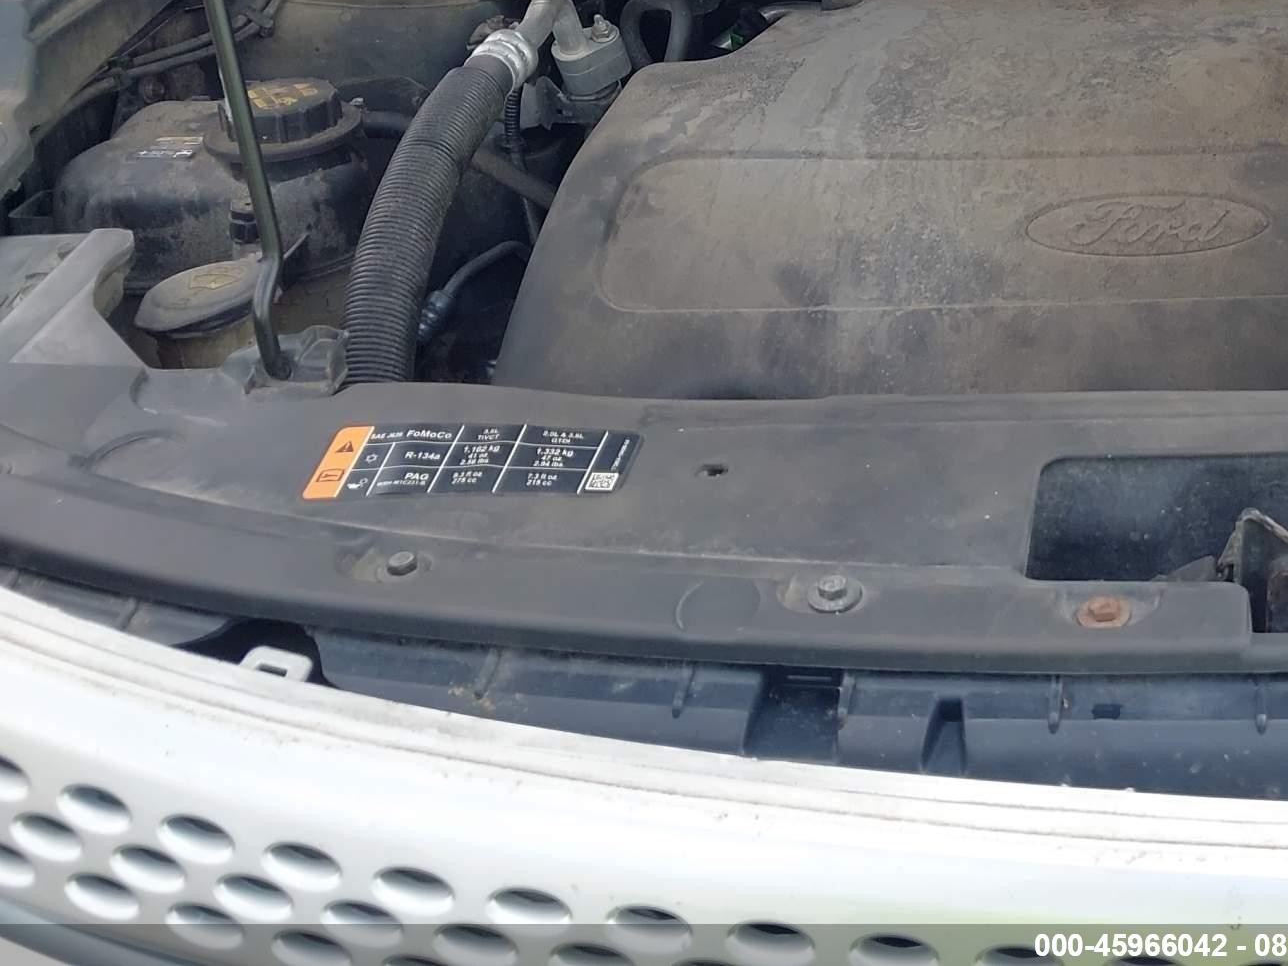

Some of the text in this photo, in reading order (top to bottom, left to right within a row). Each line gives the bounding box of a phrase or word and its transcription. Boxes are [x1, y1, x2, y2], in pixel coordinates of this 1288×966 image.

[1068, 199, 1231, 247] Ford
[406, 429, 453, 440] FoMoCo
[404, 451, 441, 461] R-134a
[562, 447, 574, 457] kg
